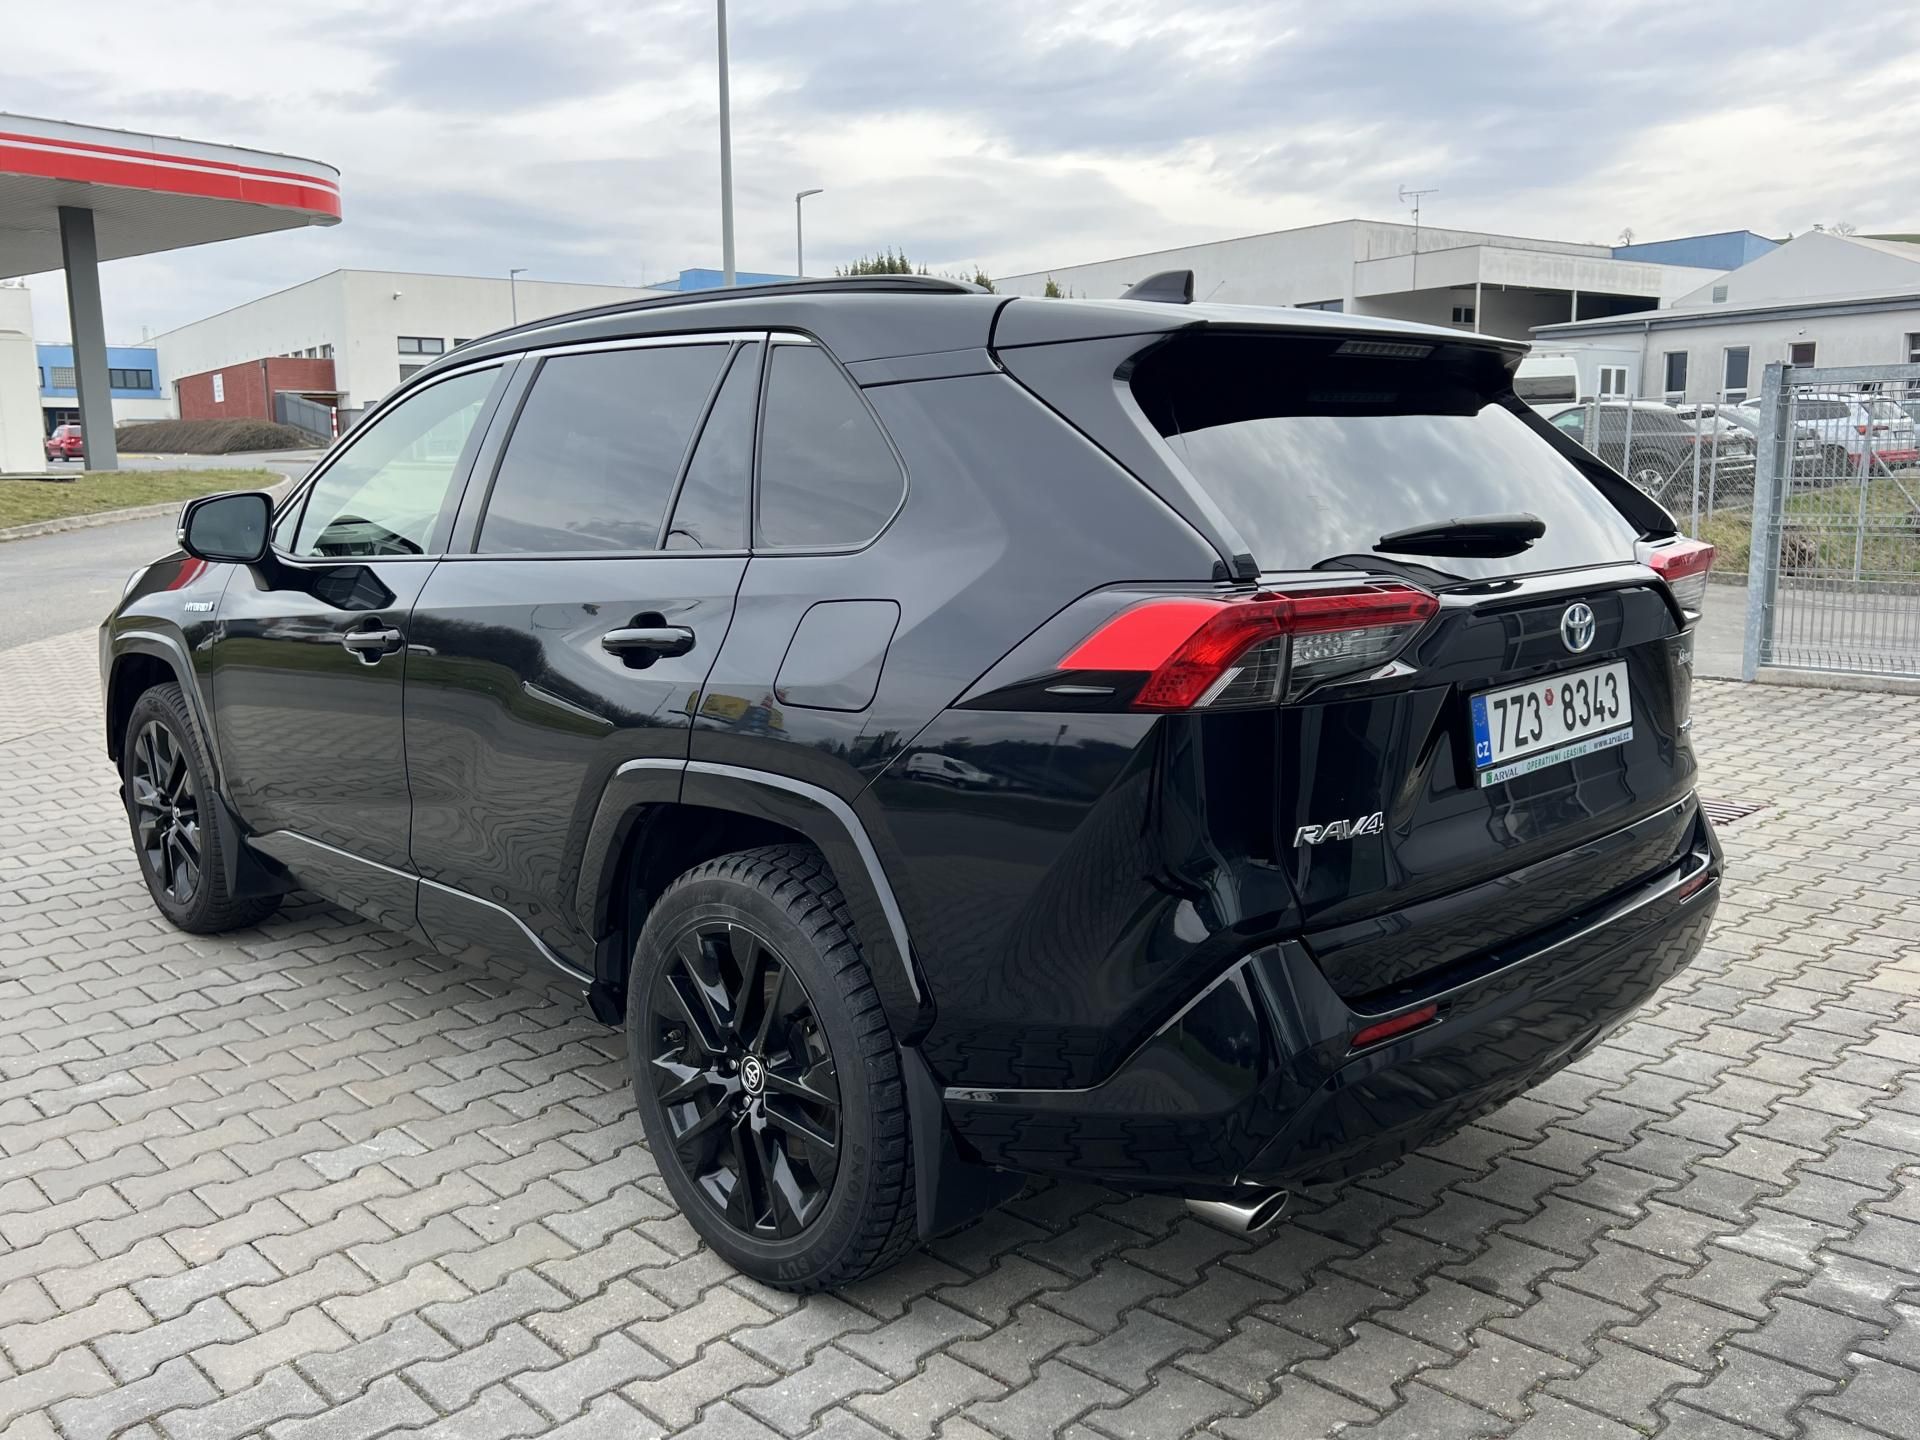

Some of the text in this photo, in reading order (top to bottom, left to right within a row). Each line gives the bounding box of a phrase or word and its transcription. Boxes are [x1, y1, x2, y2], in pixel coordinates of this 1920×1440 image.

[1493, 672, 1620, 753] 7Z3 8343
[1476, 740, 1490, 758] CZ
[1493, 767, 1519, 782] ARVAL
[1563, 744, 1587, 760] LEASING
[1293, 811, 1384, 848] RAV4
